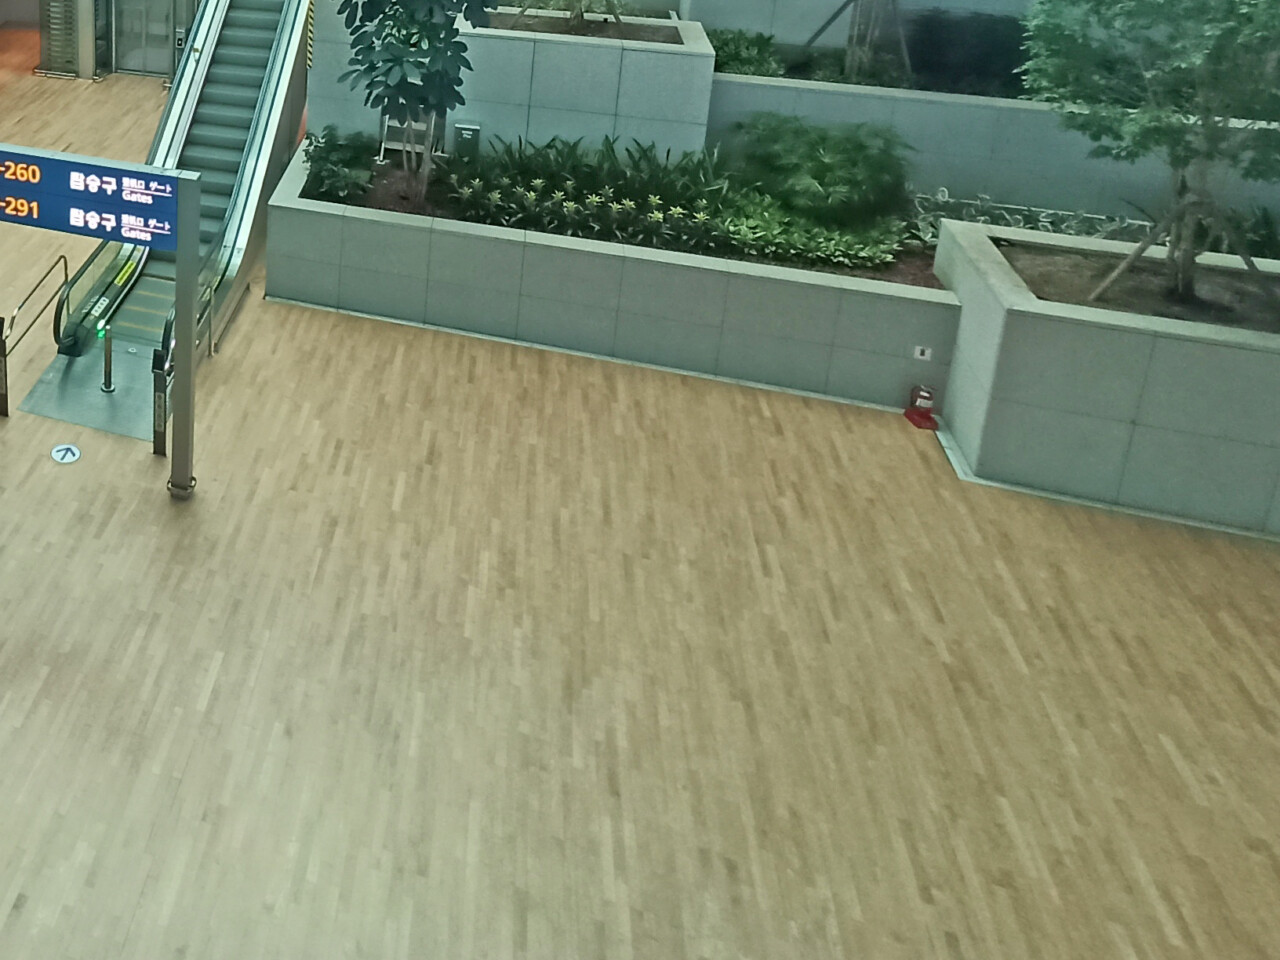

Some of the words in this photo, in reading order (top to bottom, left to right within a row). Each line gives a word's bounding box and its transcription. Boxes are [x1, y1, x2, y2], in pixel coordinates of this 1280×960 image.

[69, 171, 118, 196] 탑승구
[121, 190, 154, 205] Gates
[69, 207, 117, 232] 탑승구
[120, 227, 152, 242] Gates
